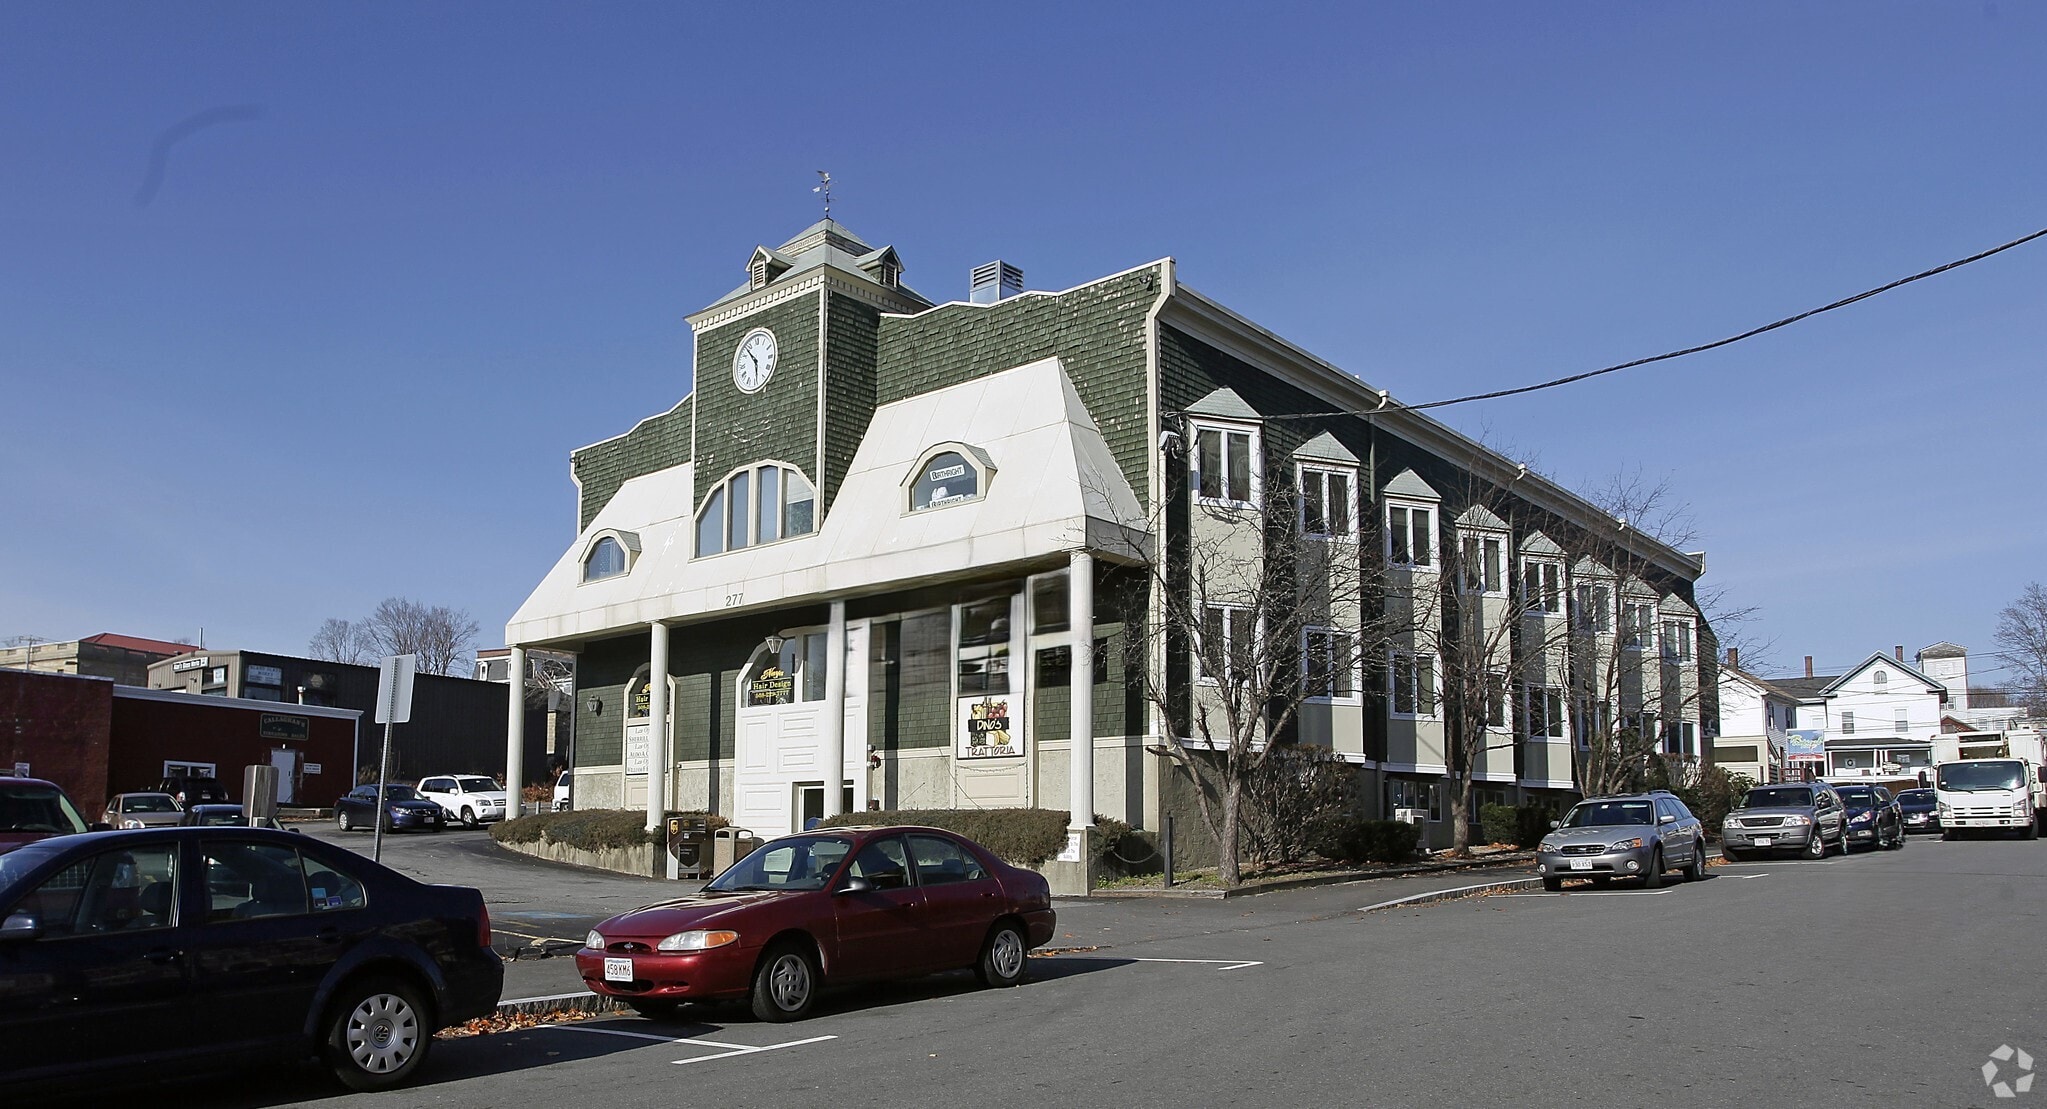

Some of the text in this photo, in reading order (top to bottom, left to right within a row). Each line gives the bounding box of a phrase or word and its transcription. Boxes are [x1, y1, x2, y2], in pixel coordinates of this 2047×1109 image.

[726, 593, 743, 606] 277
[769, 681, 791, 690] Design
[635, 695, 649, 703] Hair
[965, 746, 1015, 759] TRATTORIA
[606, 963, 618, 976] 458
